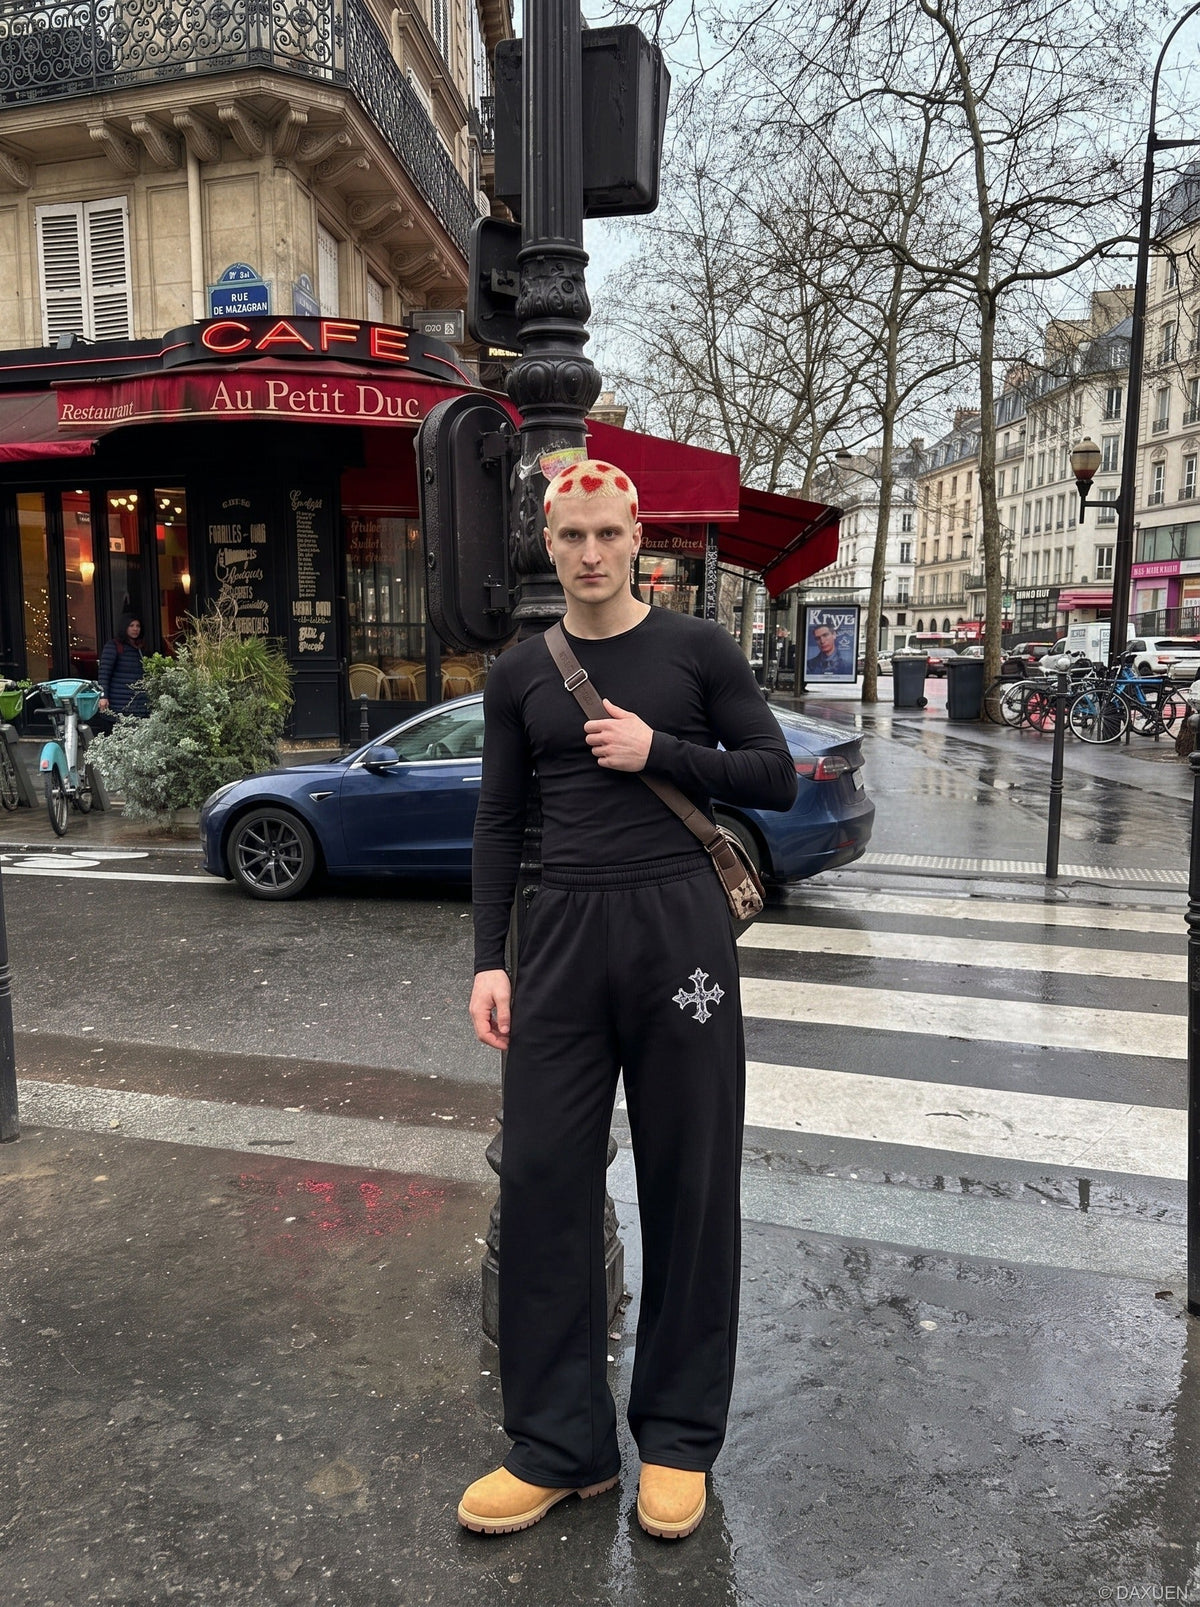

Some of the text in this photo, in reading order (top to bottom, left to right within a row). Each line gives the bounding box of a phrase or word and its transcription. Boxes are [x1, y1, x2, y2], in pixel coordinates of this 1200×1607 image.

[231, 292, 249, 302] RUE
[213, 302, 268, 315] DE MAZAGRAN
[201, 320, 410, 362] CAFE
[210, 380, 420, 417] Au Petit Duc
[60, 401, 134, 420] Restaurant
